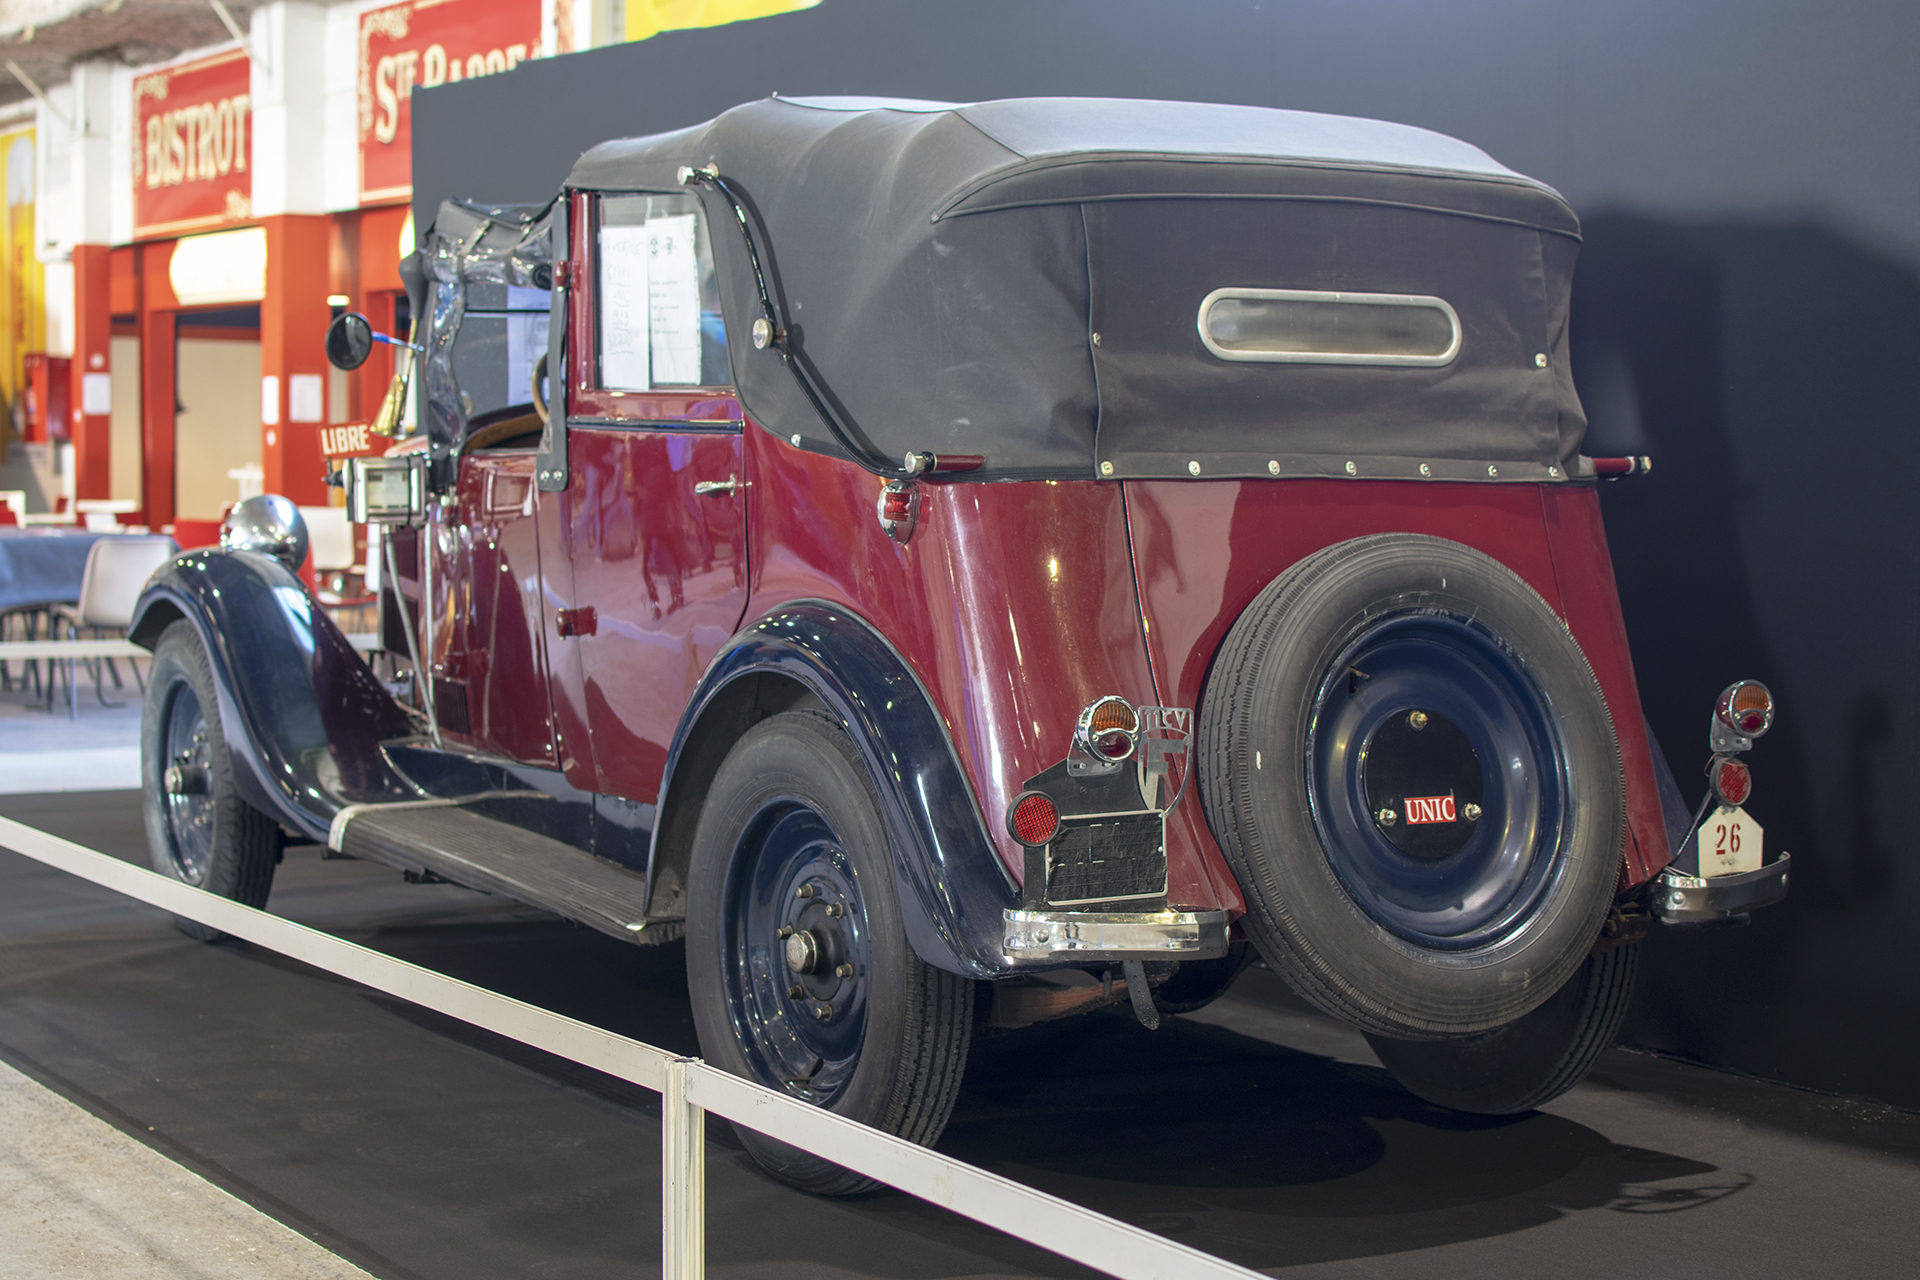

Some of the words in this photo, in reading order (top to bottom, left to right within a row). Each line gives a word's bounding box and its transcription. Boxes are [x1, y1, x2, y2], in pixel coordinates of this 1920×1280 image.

[146, 93, 250, 190] BISTROT
[321, 424, 370, 455] LIBRE
[1404, 797, 1456, 823] UNIC
[1716, 823, 1741, 855] 26
